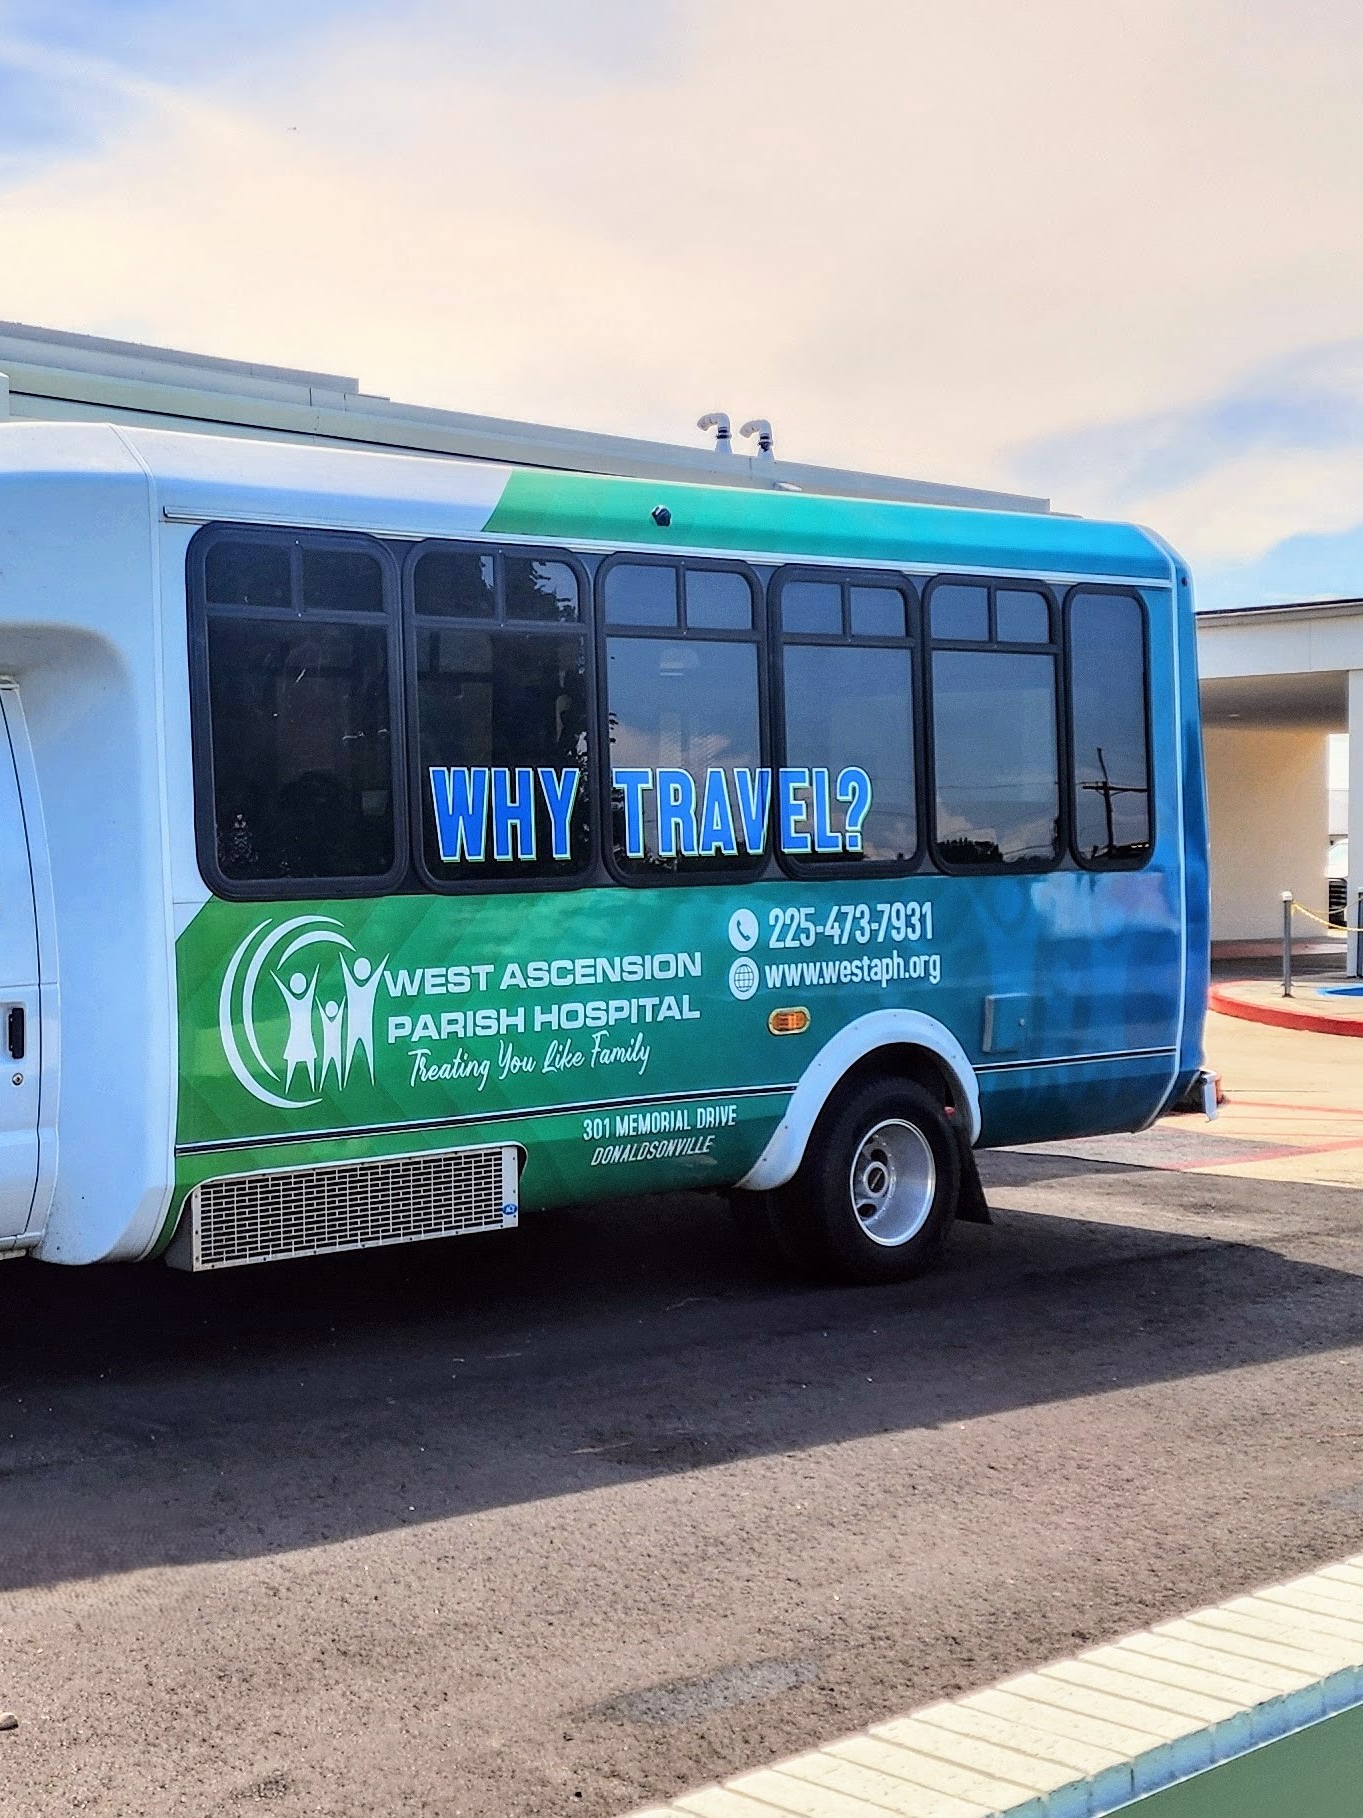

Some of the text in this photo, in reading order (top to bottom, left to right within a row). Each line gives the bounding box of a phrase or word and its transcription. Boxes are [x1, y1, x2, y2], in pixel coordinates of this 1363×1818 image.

[429, 767, 874, 863] WHY TRAVEL?
[768, 901, 933, 949] 225-473-7931
[384, 951, 702, 997] WEST ASCENSION
[765, 950, 941, 988] www.westaph.org
[388, 994, 701, 1044] PARISH HOSPITAL
[408, 1029, 651, 1092] Treating You Like Family
[583, 1104, 738, 1141] 301 MEMORIAL DRIVE
[590, 1135, 716, 1166] DONALDSONVILLE
